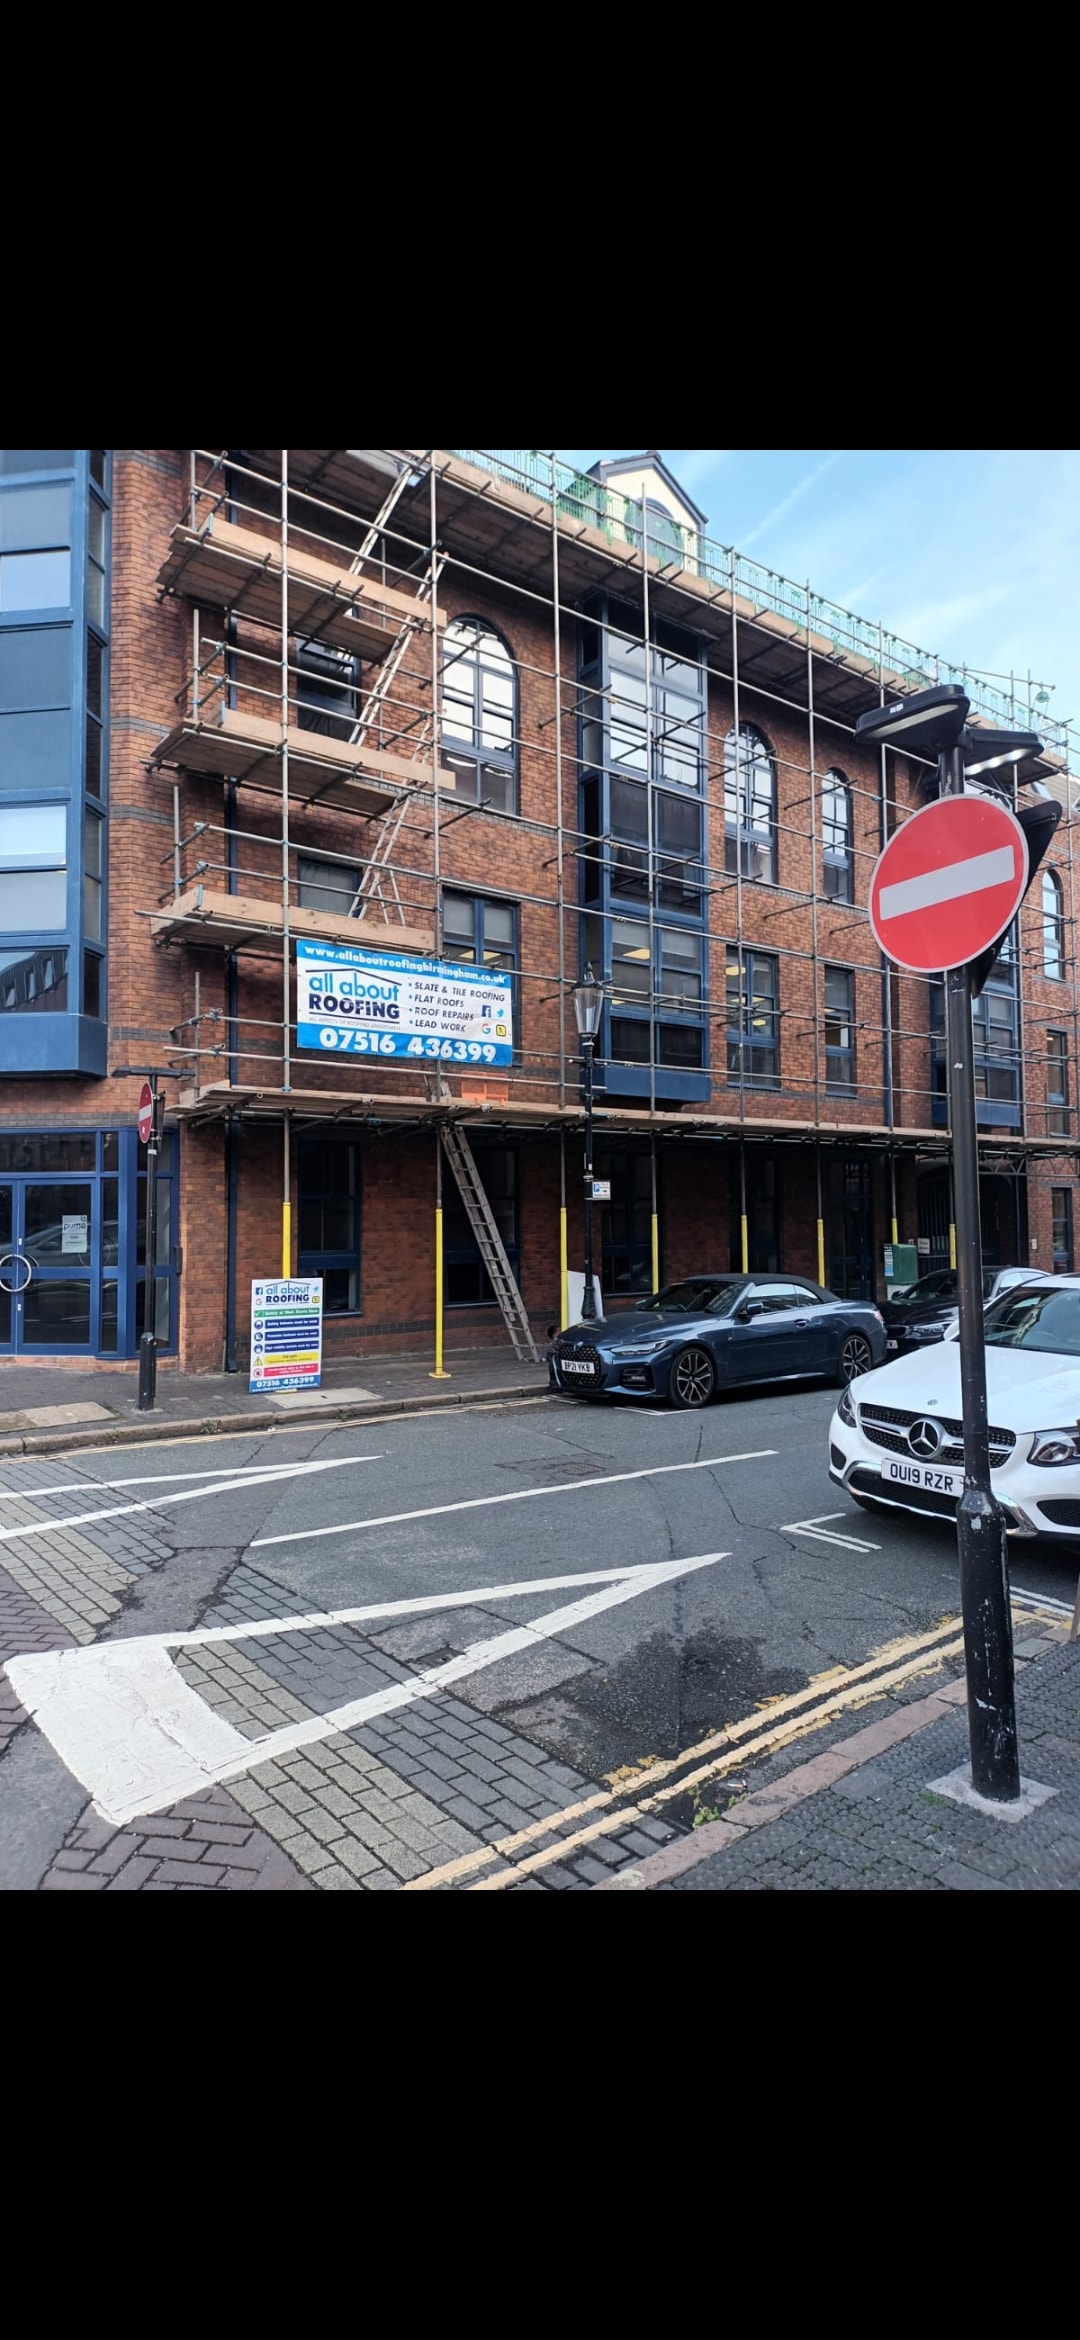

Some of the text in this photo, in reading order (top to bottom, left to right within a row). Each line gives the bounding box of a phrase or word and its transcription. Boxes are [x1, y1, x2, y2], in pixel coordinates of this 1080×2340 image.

[304, 945, 505, 984] www.allaboutroofingbirmingham.co.uk
[309, 972, 399, 1001] all about
[414, 981, 505, 1002] SLATE & TILE ROOFING
[309, 993, 400, 1019] ROOFING
[414, 994, 465, 1008] FLAT ROOFS
[414, 1007, 475, 1021] ROOF REPAIRS
[415, 1019, 466, 1032] LEAD WORK
[319, 1027, 497, 1062] 07516 436399
[266, 1282, 310, 1295] all about
[266, 1294, 310, 1303] ROOFING
[282, 1376, 315, 1385] 436399
[890, 1463, 954, 1492] OU19 RZR
